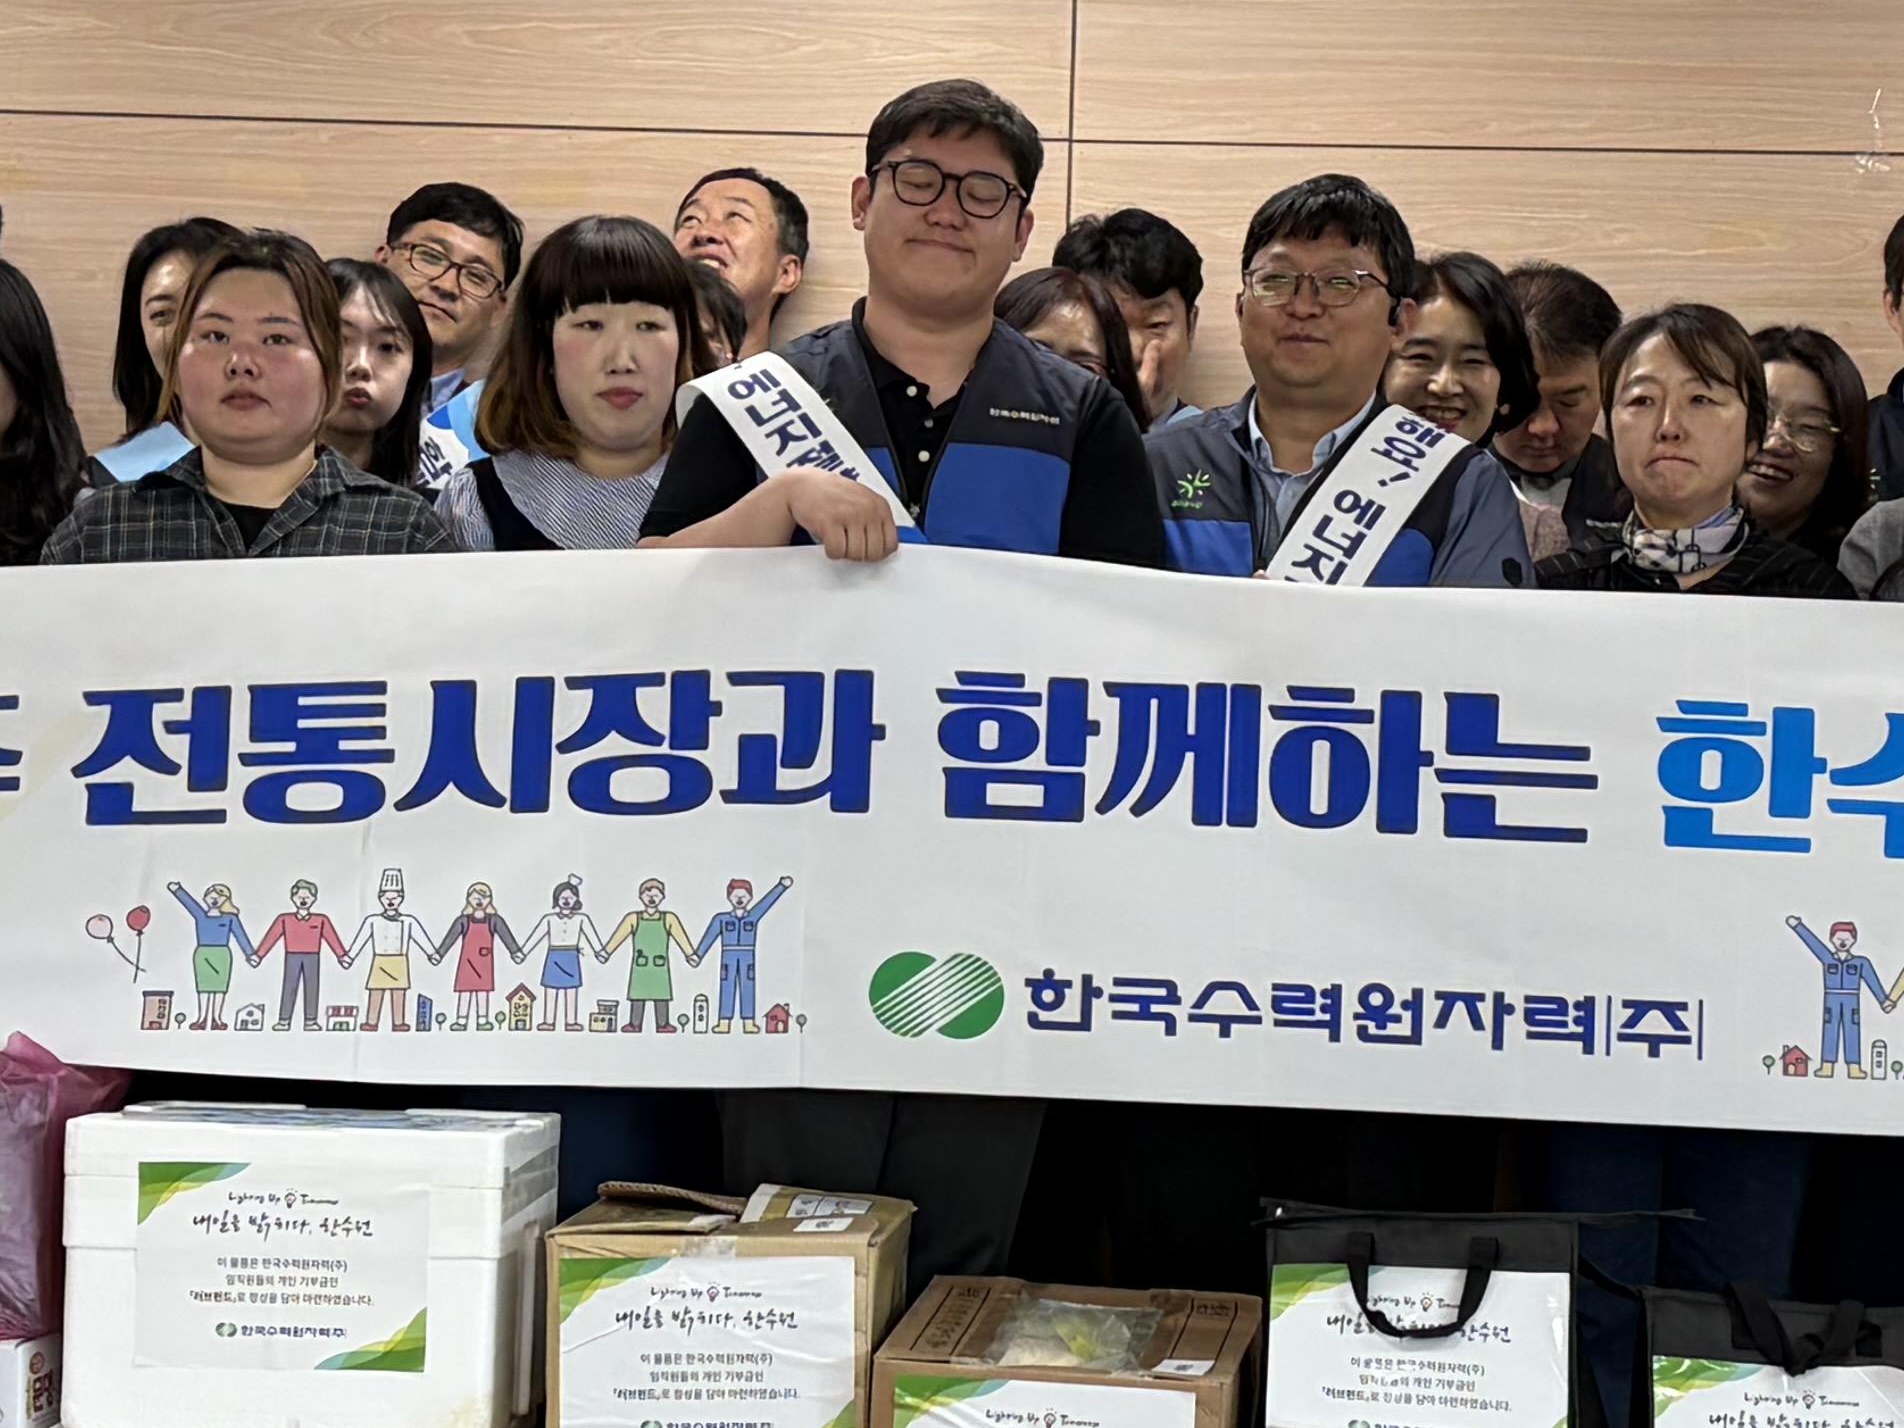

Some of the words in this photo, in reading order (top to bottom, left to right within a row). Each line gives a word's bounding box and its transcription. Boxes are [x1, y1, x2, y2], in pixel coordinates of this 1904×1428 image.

[727, 368, 823, 457] 에너지
[1370, 415, 1446, 488] 해요!
[1291, 489, 1386, 585] 에너지
[71, 668, 886, 828] 전통시장과
[935, 670, 1599, 844] 함께하는
